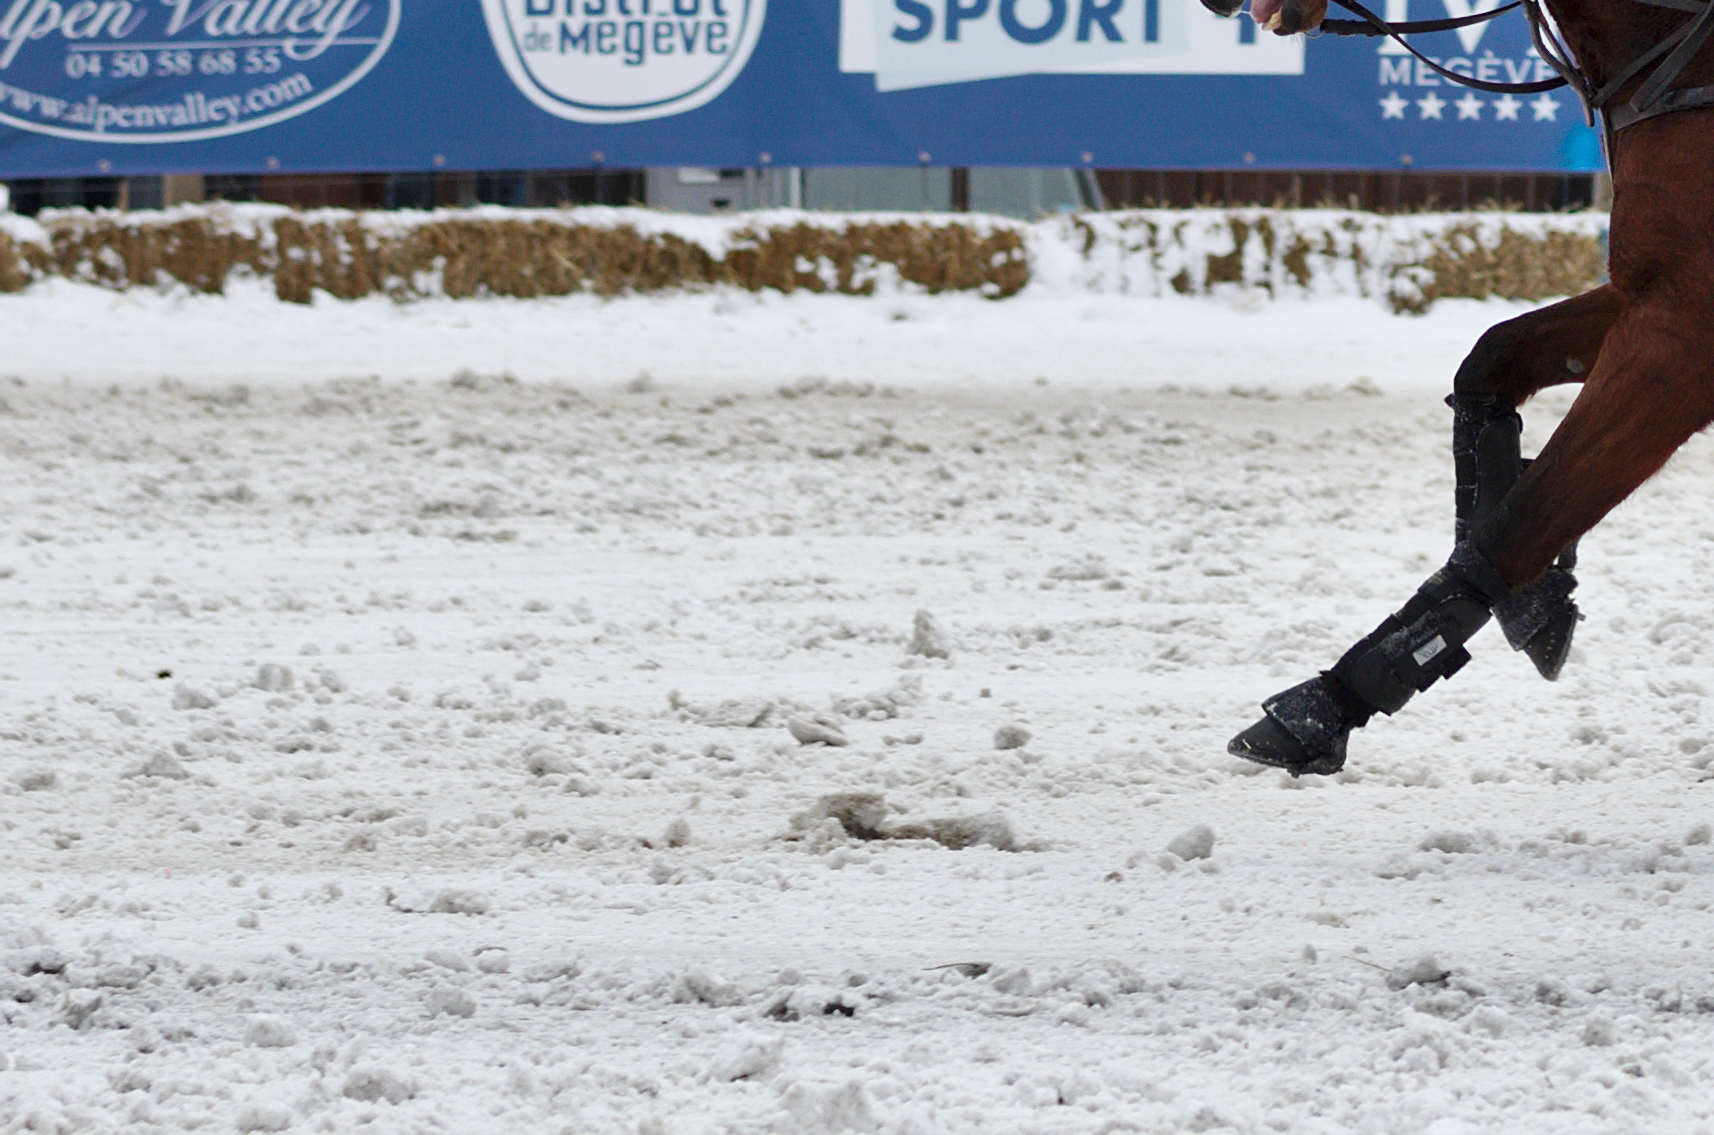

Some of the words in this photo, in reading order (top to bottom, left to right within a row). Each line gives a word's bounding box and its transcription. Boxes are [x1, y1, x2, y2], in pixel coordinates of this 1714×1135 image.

[523, 21, 552, 52] de
[65, 52, 103, 79] 04
[110, 51, 150, 78] 50
[154, 49, 193, 77] 58
[200, 49, 237, 76] 68
[243, 47, 282, 74] 55
